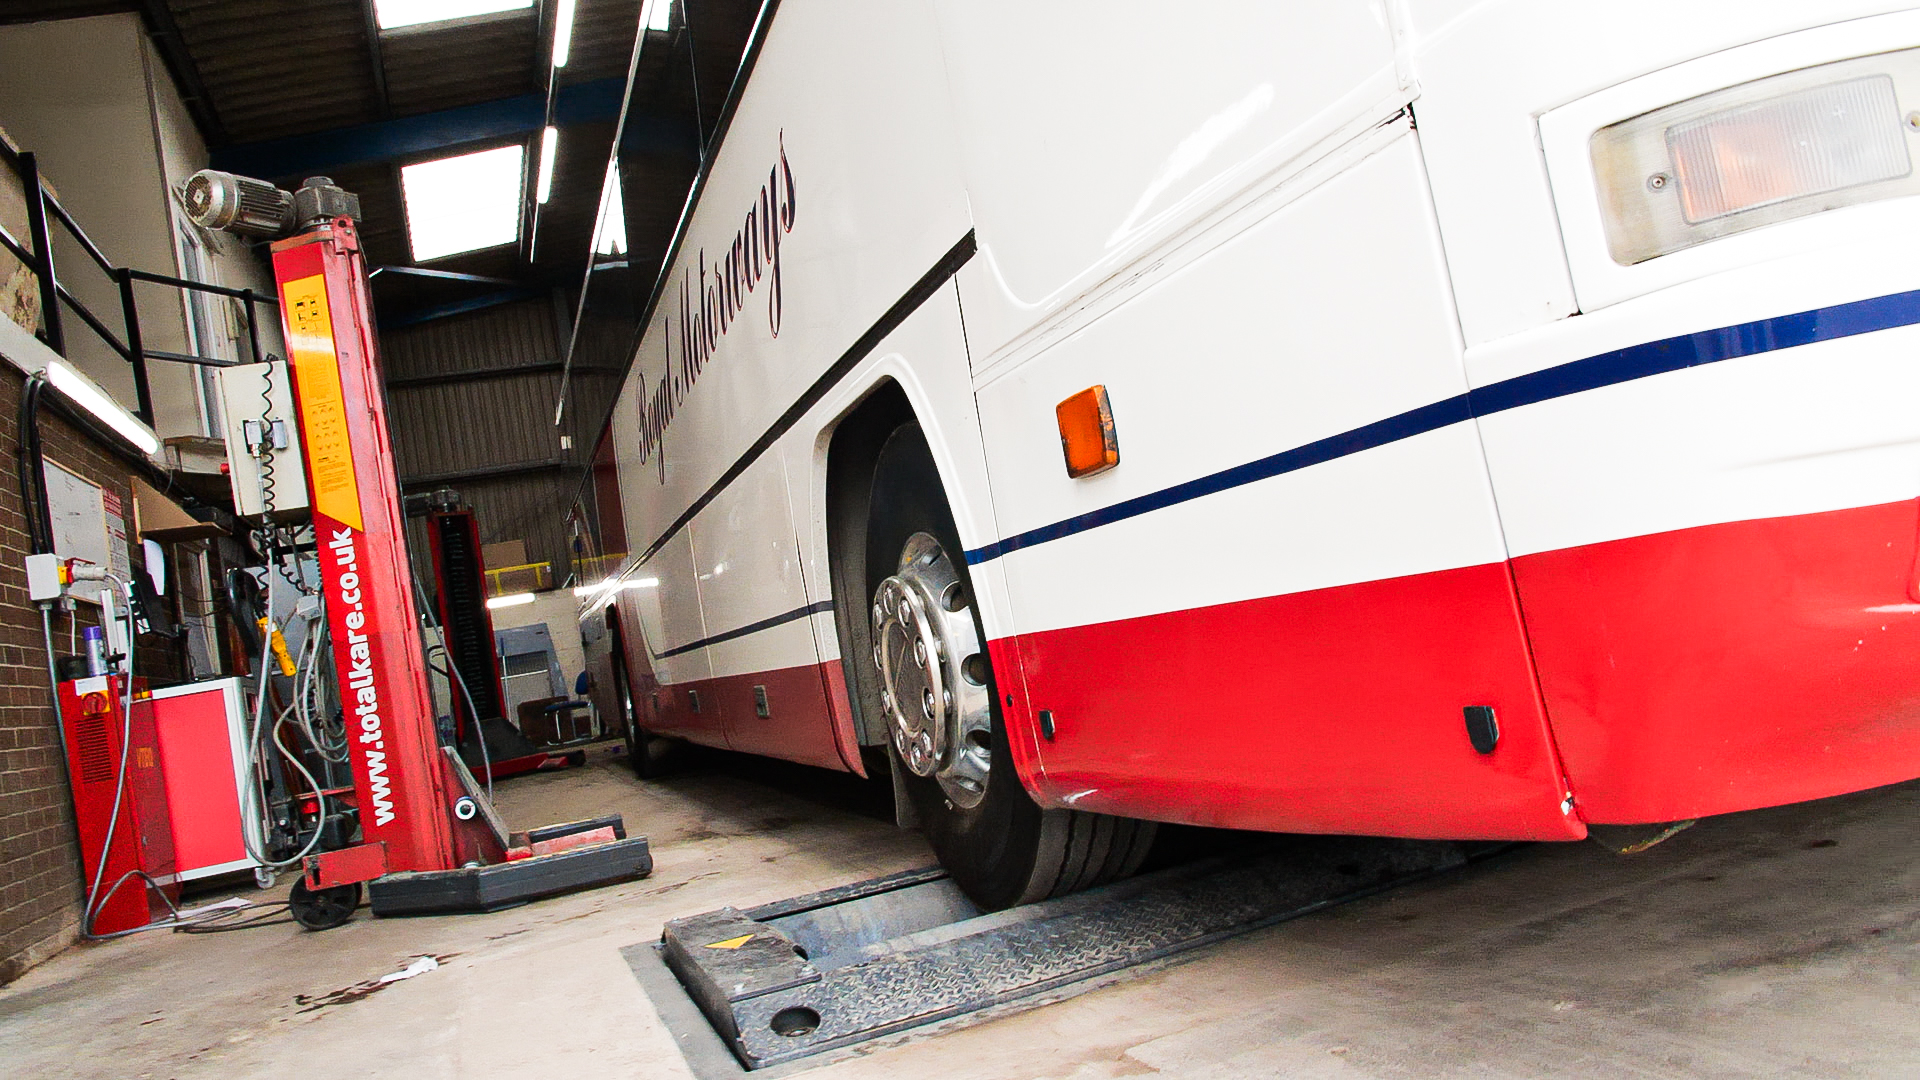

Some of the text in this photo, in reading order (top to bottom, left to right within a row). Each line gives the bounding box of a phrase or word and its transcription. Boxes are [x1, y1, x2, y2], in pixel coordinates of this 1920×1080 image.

[635, 127, 796, 485] Royal Motorways
[329, 526, 396, 826] www.totalkare.co.uk
